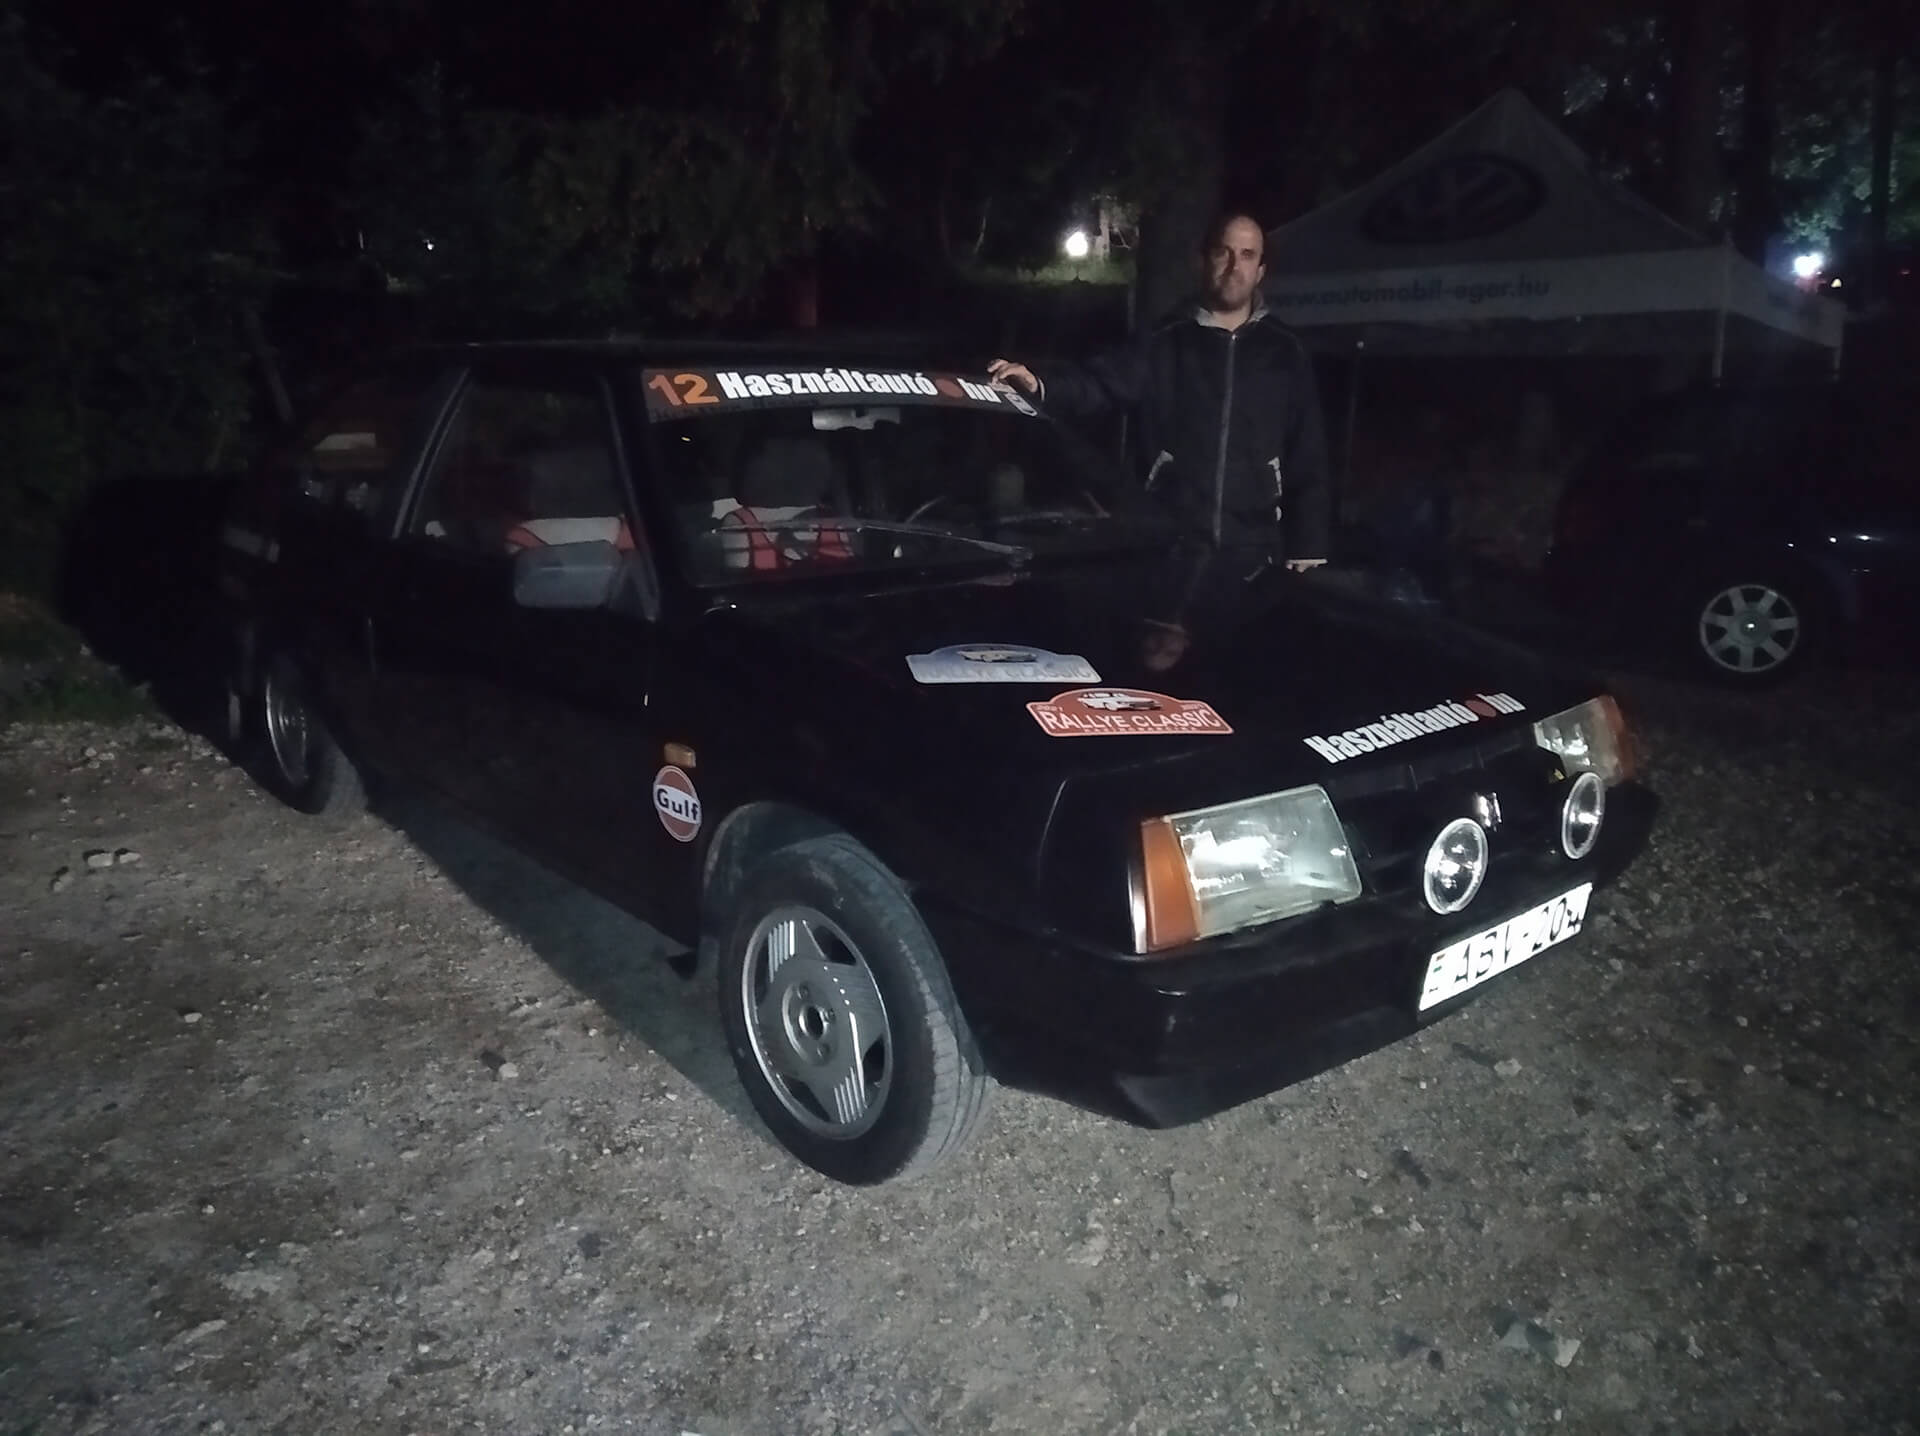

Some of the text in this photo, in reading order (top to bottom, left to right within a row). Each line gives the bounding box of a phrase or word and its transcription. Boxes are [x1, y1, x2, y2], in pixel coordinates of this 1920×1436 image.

[648, 373, 720, 406] 12
[1037, 709, 1222, 730] RALLYE CLASSIC
[657, 788, 698, 820] Gulf
